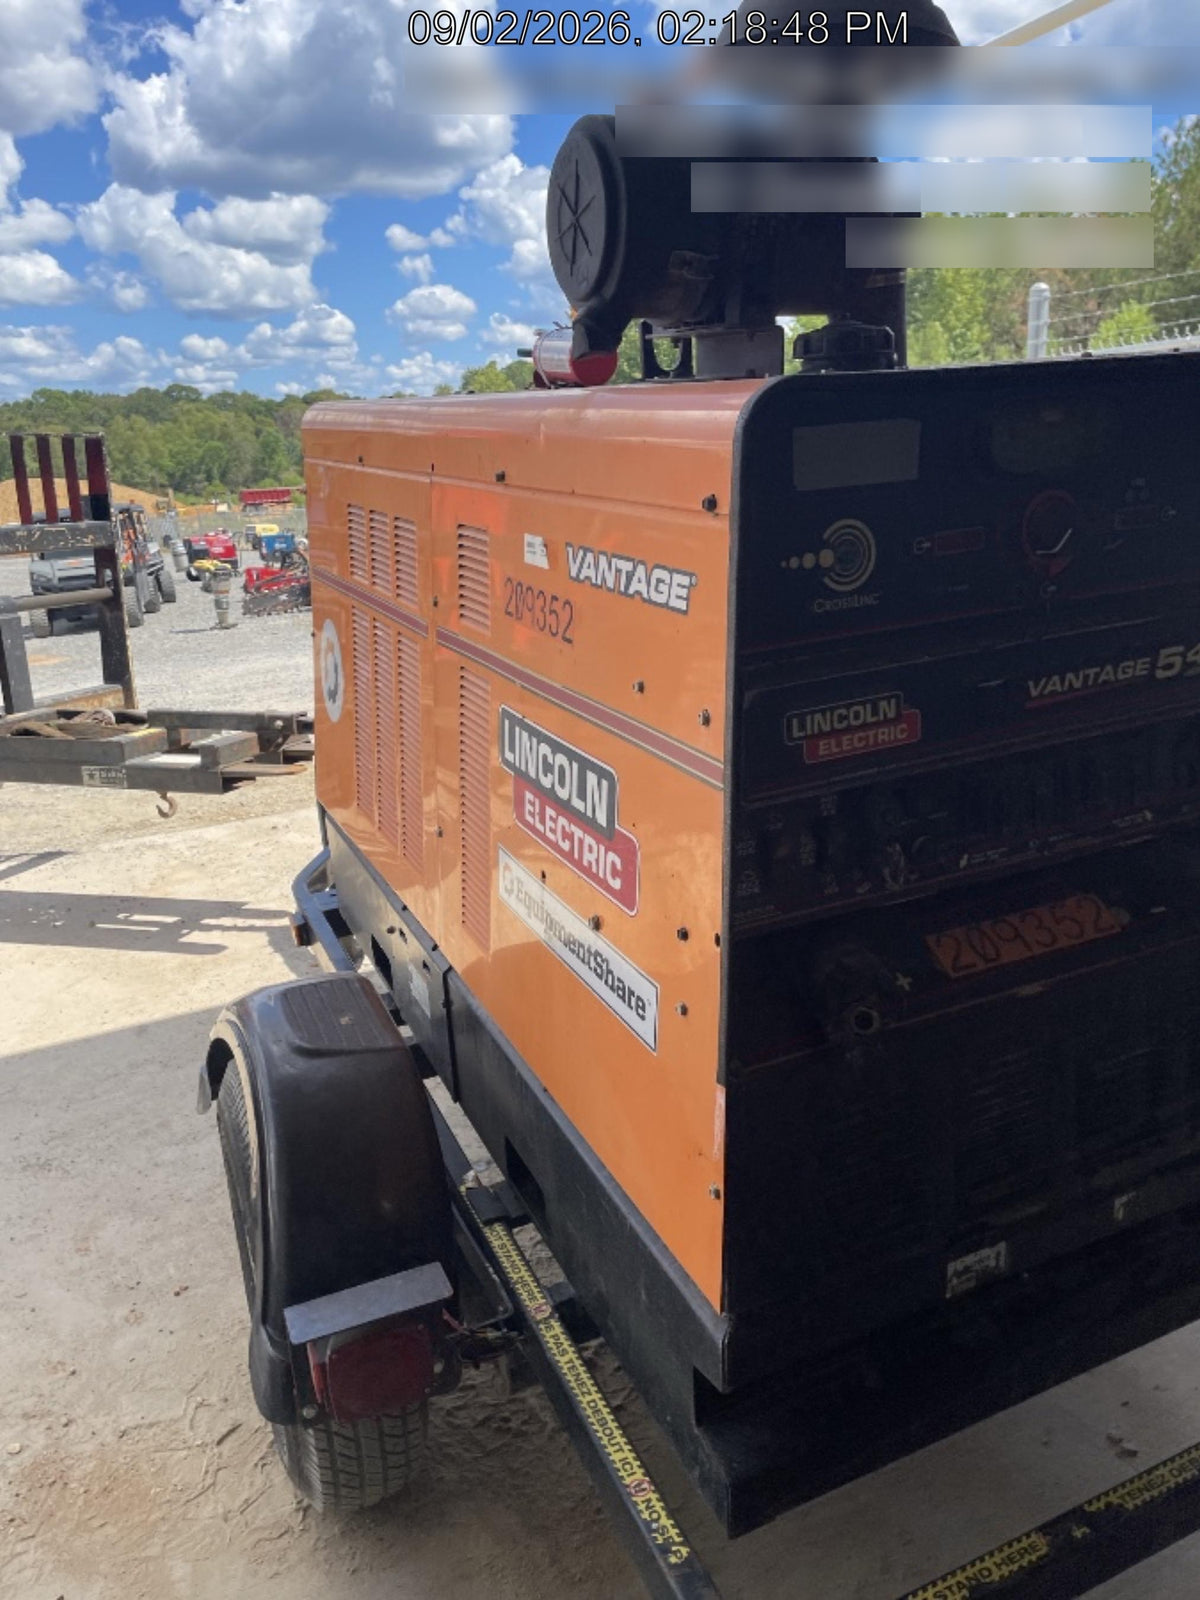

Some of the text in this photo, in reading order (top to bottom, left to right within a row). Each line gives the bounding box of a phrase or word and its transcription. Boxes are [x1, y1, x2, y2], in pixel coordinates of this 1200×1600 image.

[504, 576, 575, 645] 209352
[566, 544, 692, 613] VANTAGE
[1027, 657, 1152, 698] VANTAGE
[790, 697, 897, 738] LINCOLN
[817, 723, 909, 757] ELECTRIC
[502, 717, 609, 829] LINCOLN
[523, 790, 624, 892] ELECTRIC
[514, 874, 648, 1023] EquipmentShare
[935, 892, 1117, 974] 209352
[515, 1275, 540, 1304] HERE
[547, 1332, 568, 1359] PAS
[562, 1355, 593, 1398] TENEZ
[586, 1399, 625, 1455] DEBOUT
[641, 1497, 662, 1522] NO
[993, 1539, 1043, 1571] HERE
